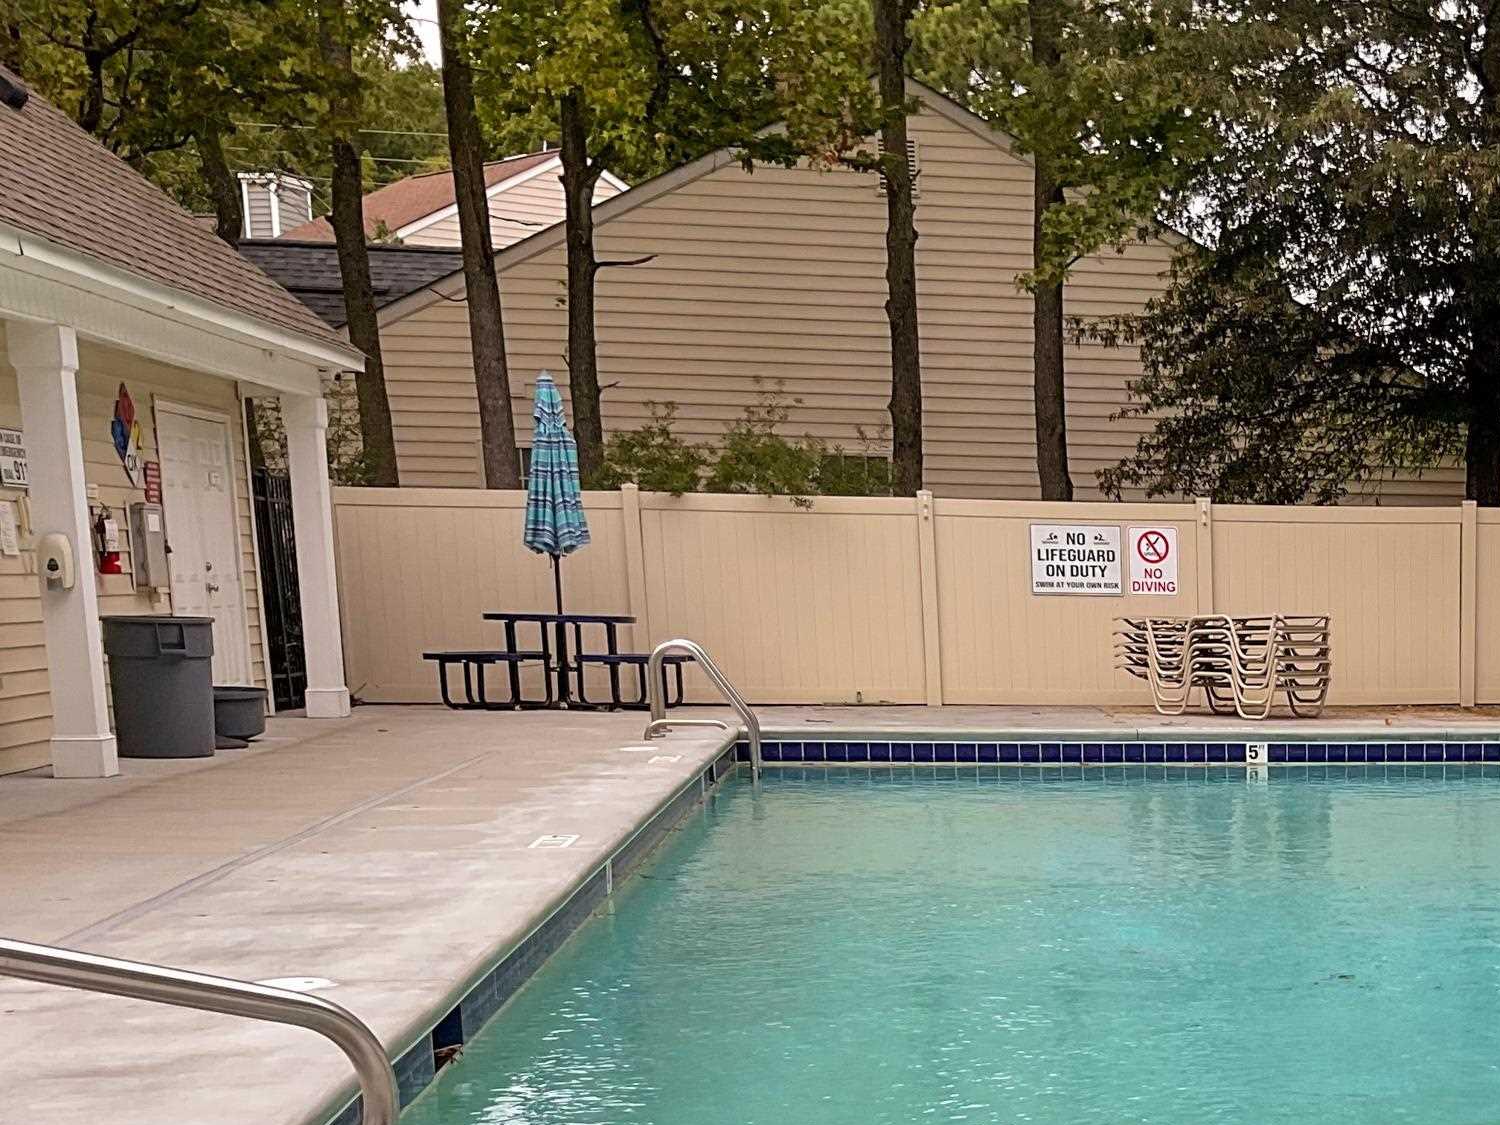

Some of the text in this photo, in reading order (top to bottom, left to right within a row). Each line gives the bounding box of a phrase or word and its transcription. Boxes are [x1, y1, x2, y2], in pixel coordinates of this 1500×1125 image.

[1066, 532, 1086, 546] NO
[1037, 548, 1116, 562] LIFEGUARD
[1046, 564, 1107, 578] ON DUTY
[1144, 568, 1163, 579] NO
[1132, 581, 1176, 593] DIVING
